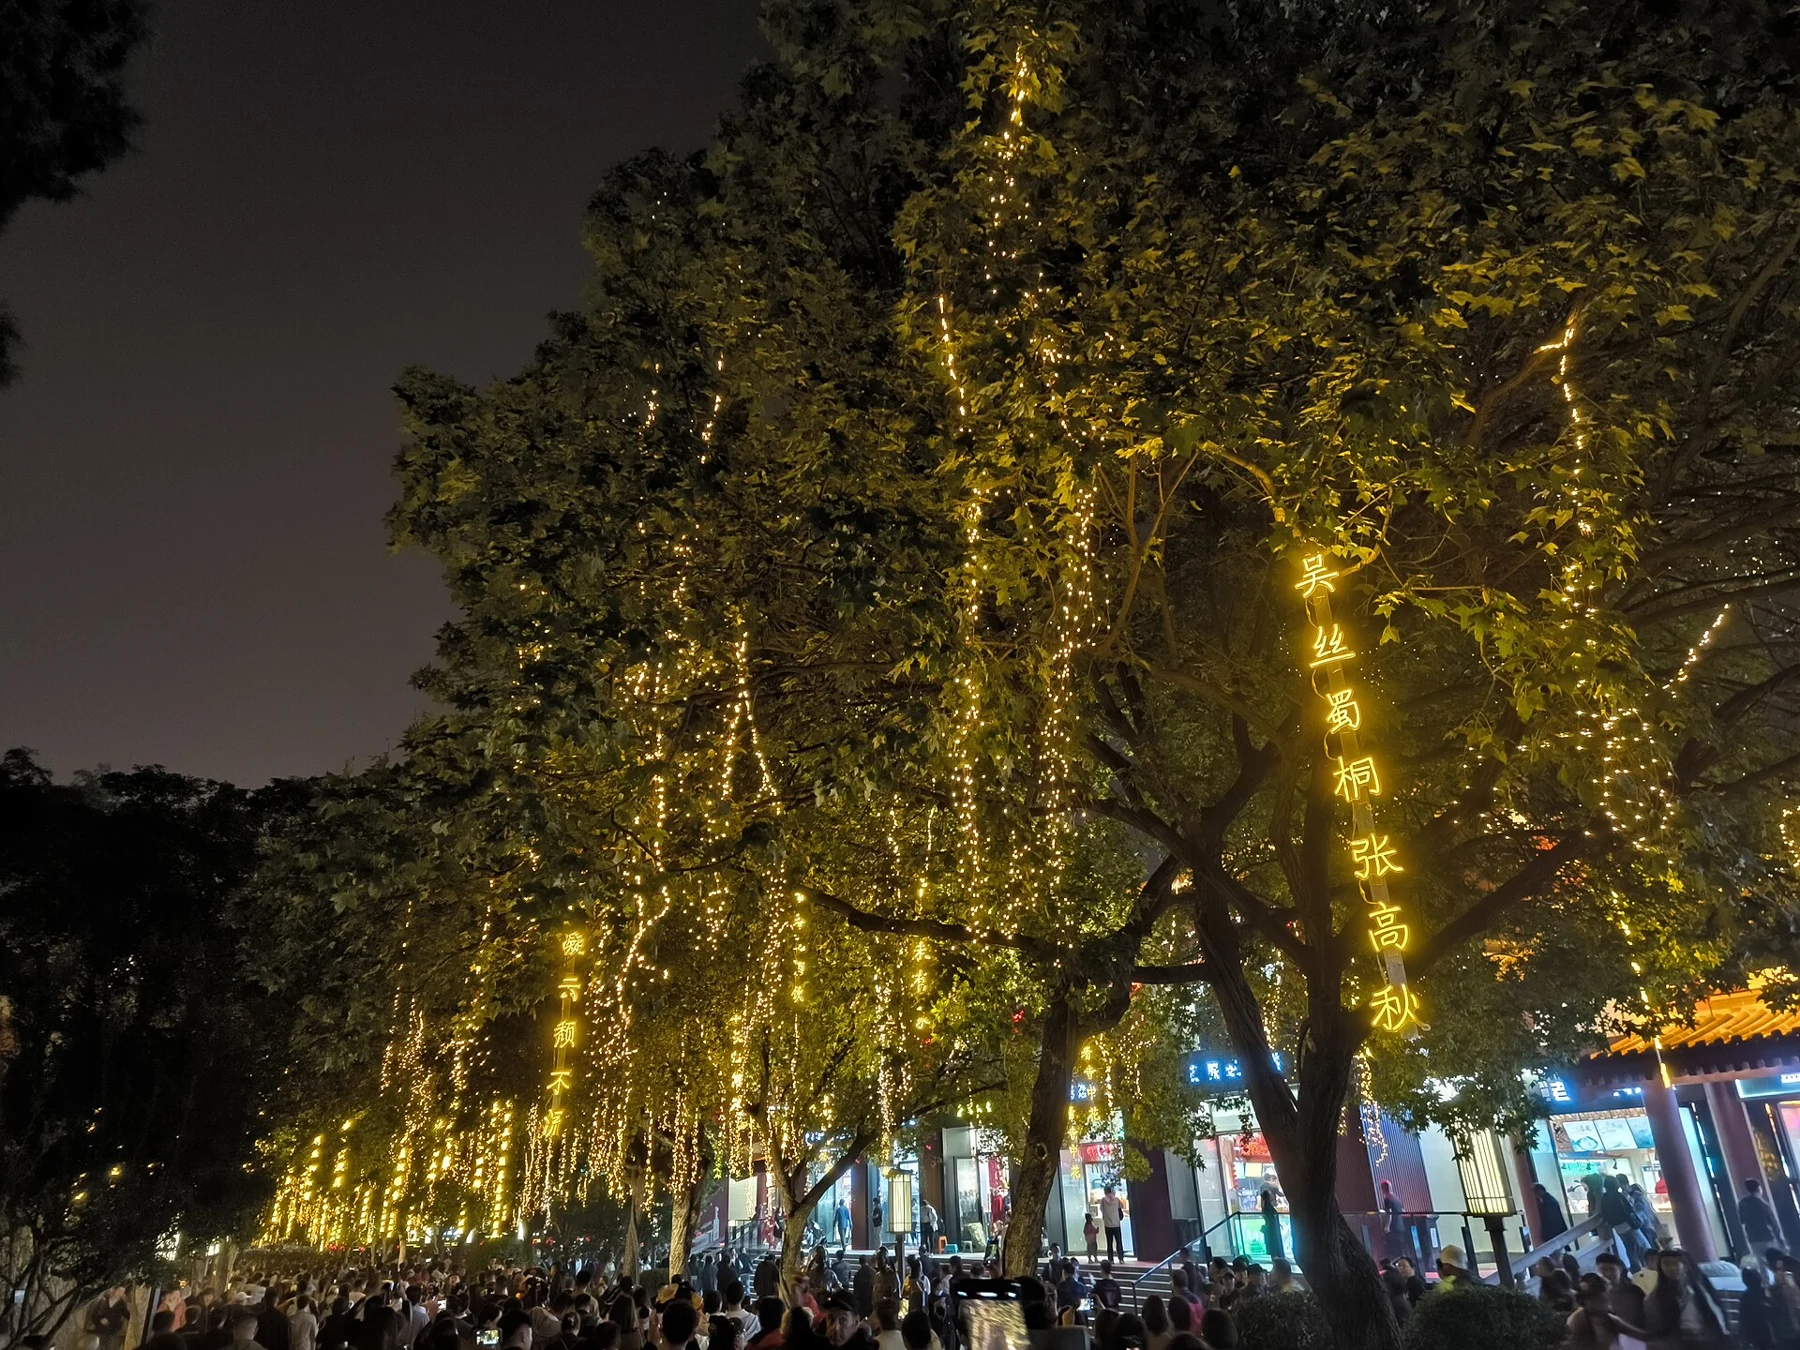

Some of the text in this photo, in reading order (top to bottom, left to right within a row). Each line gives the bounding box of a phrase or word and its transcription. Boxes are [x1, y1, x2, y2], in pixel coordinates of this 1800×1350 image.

[1295, 553, 1431, 1033] 吴丝蜀桐张高秋
